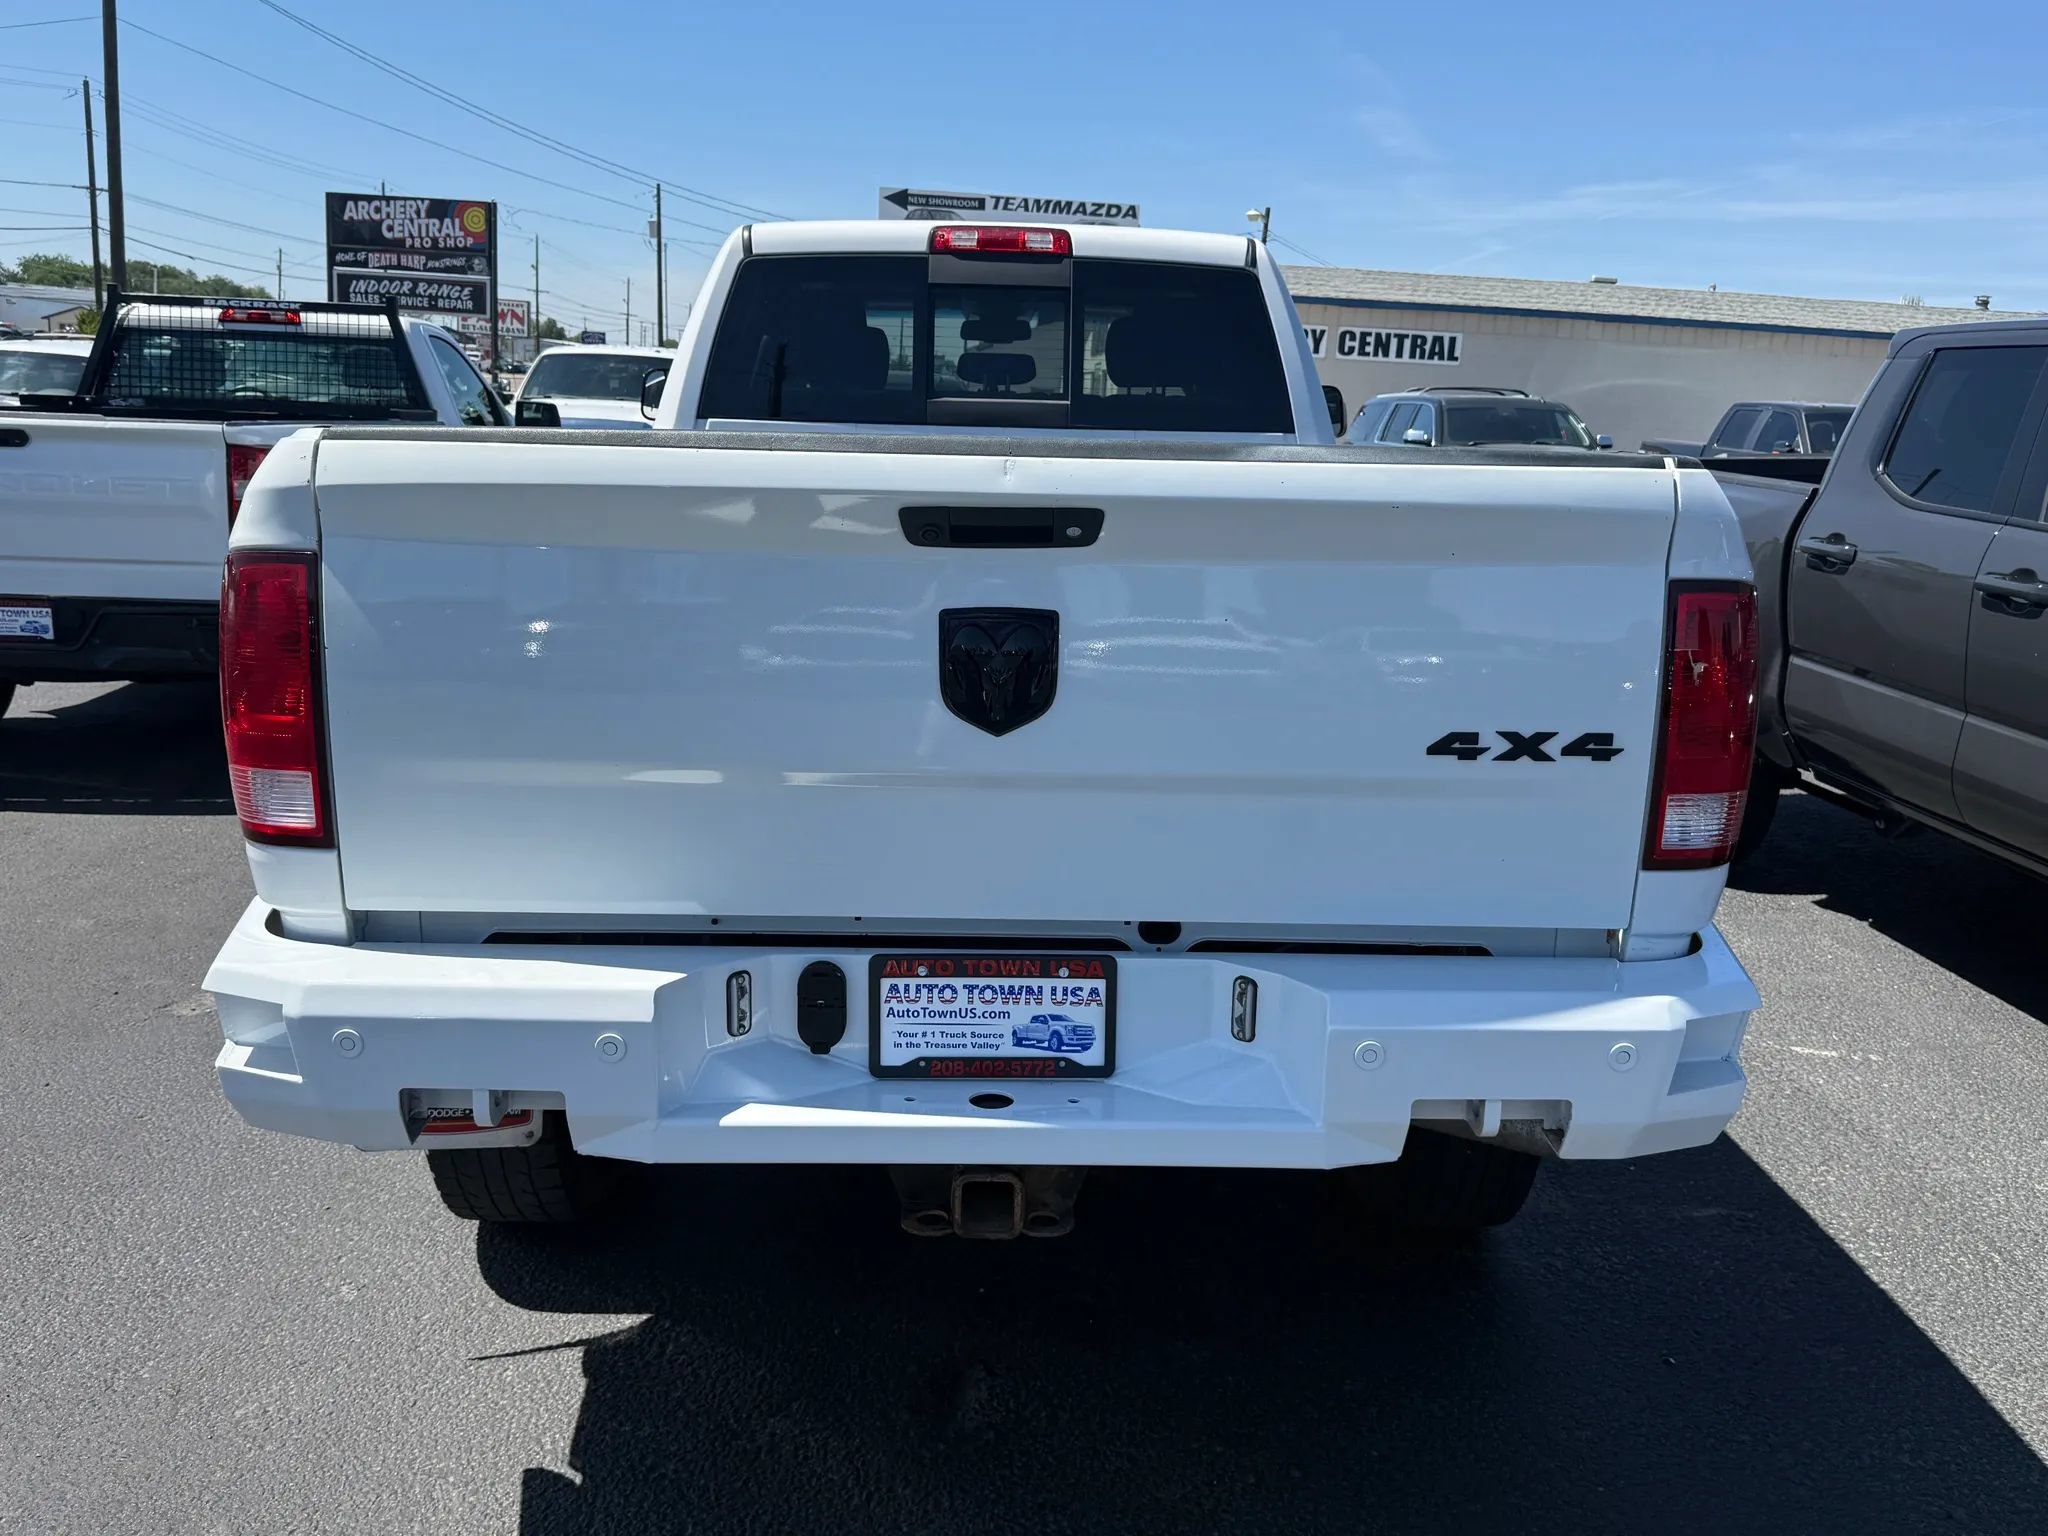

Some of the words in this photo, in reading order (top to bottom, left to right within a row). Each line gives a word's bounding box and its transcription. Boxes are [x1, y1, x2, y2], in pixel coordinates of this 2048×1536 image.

[343, 200, 430, 221] ARCHERY
[908, 195, 926, 205] NEW
[927, 196, 980, 209] SHOWROOM
[381, 218, 465, 239] CENTRAL
[405, 237, 431, 249] PRO
[437, 236, 475, 248] SHOP
[368, 252, 398, 268] DEATH
[400, 254, 426, 271] HARP
[349, 279, 413, 295] INDOOR
[416, 281, 473, 300] RANGE
[203, 298, 303, 310] BACKRACK
[350, 293, 380, 304] SALES
[437, 298, 473, 311] REPAIR
[1337, 329, 1460, 362] CENTRAL
[1426, 730, 1625, 762] 4X4
[882, 959, 955, 976] AUTO
[961, 959, 1041, 977] TOWN
[1049, 960, 1105, 977] USA
[884, 982, 958, 1006] AUTO
[962, 983, 1044, 1006] TOWN
[1050, 985, 1104, 1008] USA
[886, 1006, 1011, 1020] AutoTownUS.com
[921, 1030, 928, 1039] #
[938, 1030, 967, 1039] Truck
[970, 1031, 1005, 1040] Source
[893, 1041, 904, 1049] in
[905, 1041, 921, 1049] the
[924, 1041, 968, 1050] Treasure
[930, 1060, 1056, 1076] 208-402-5772
[427, 1108, 465, 1118] DODGE
